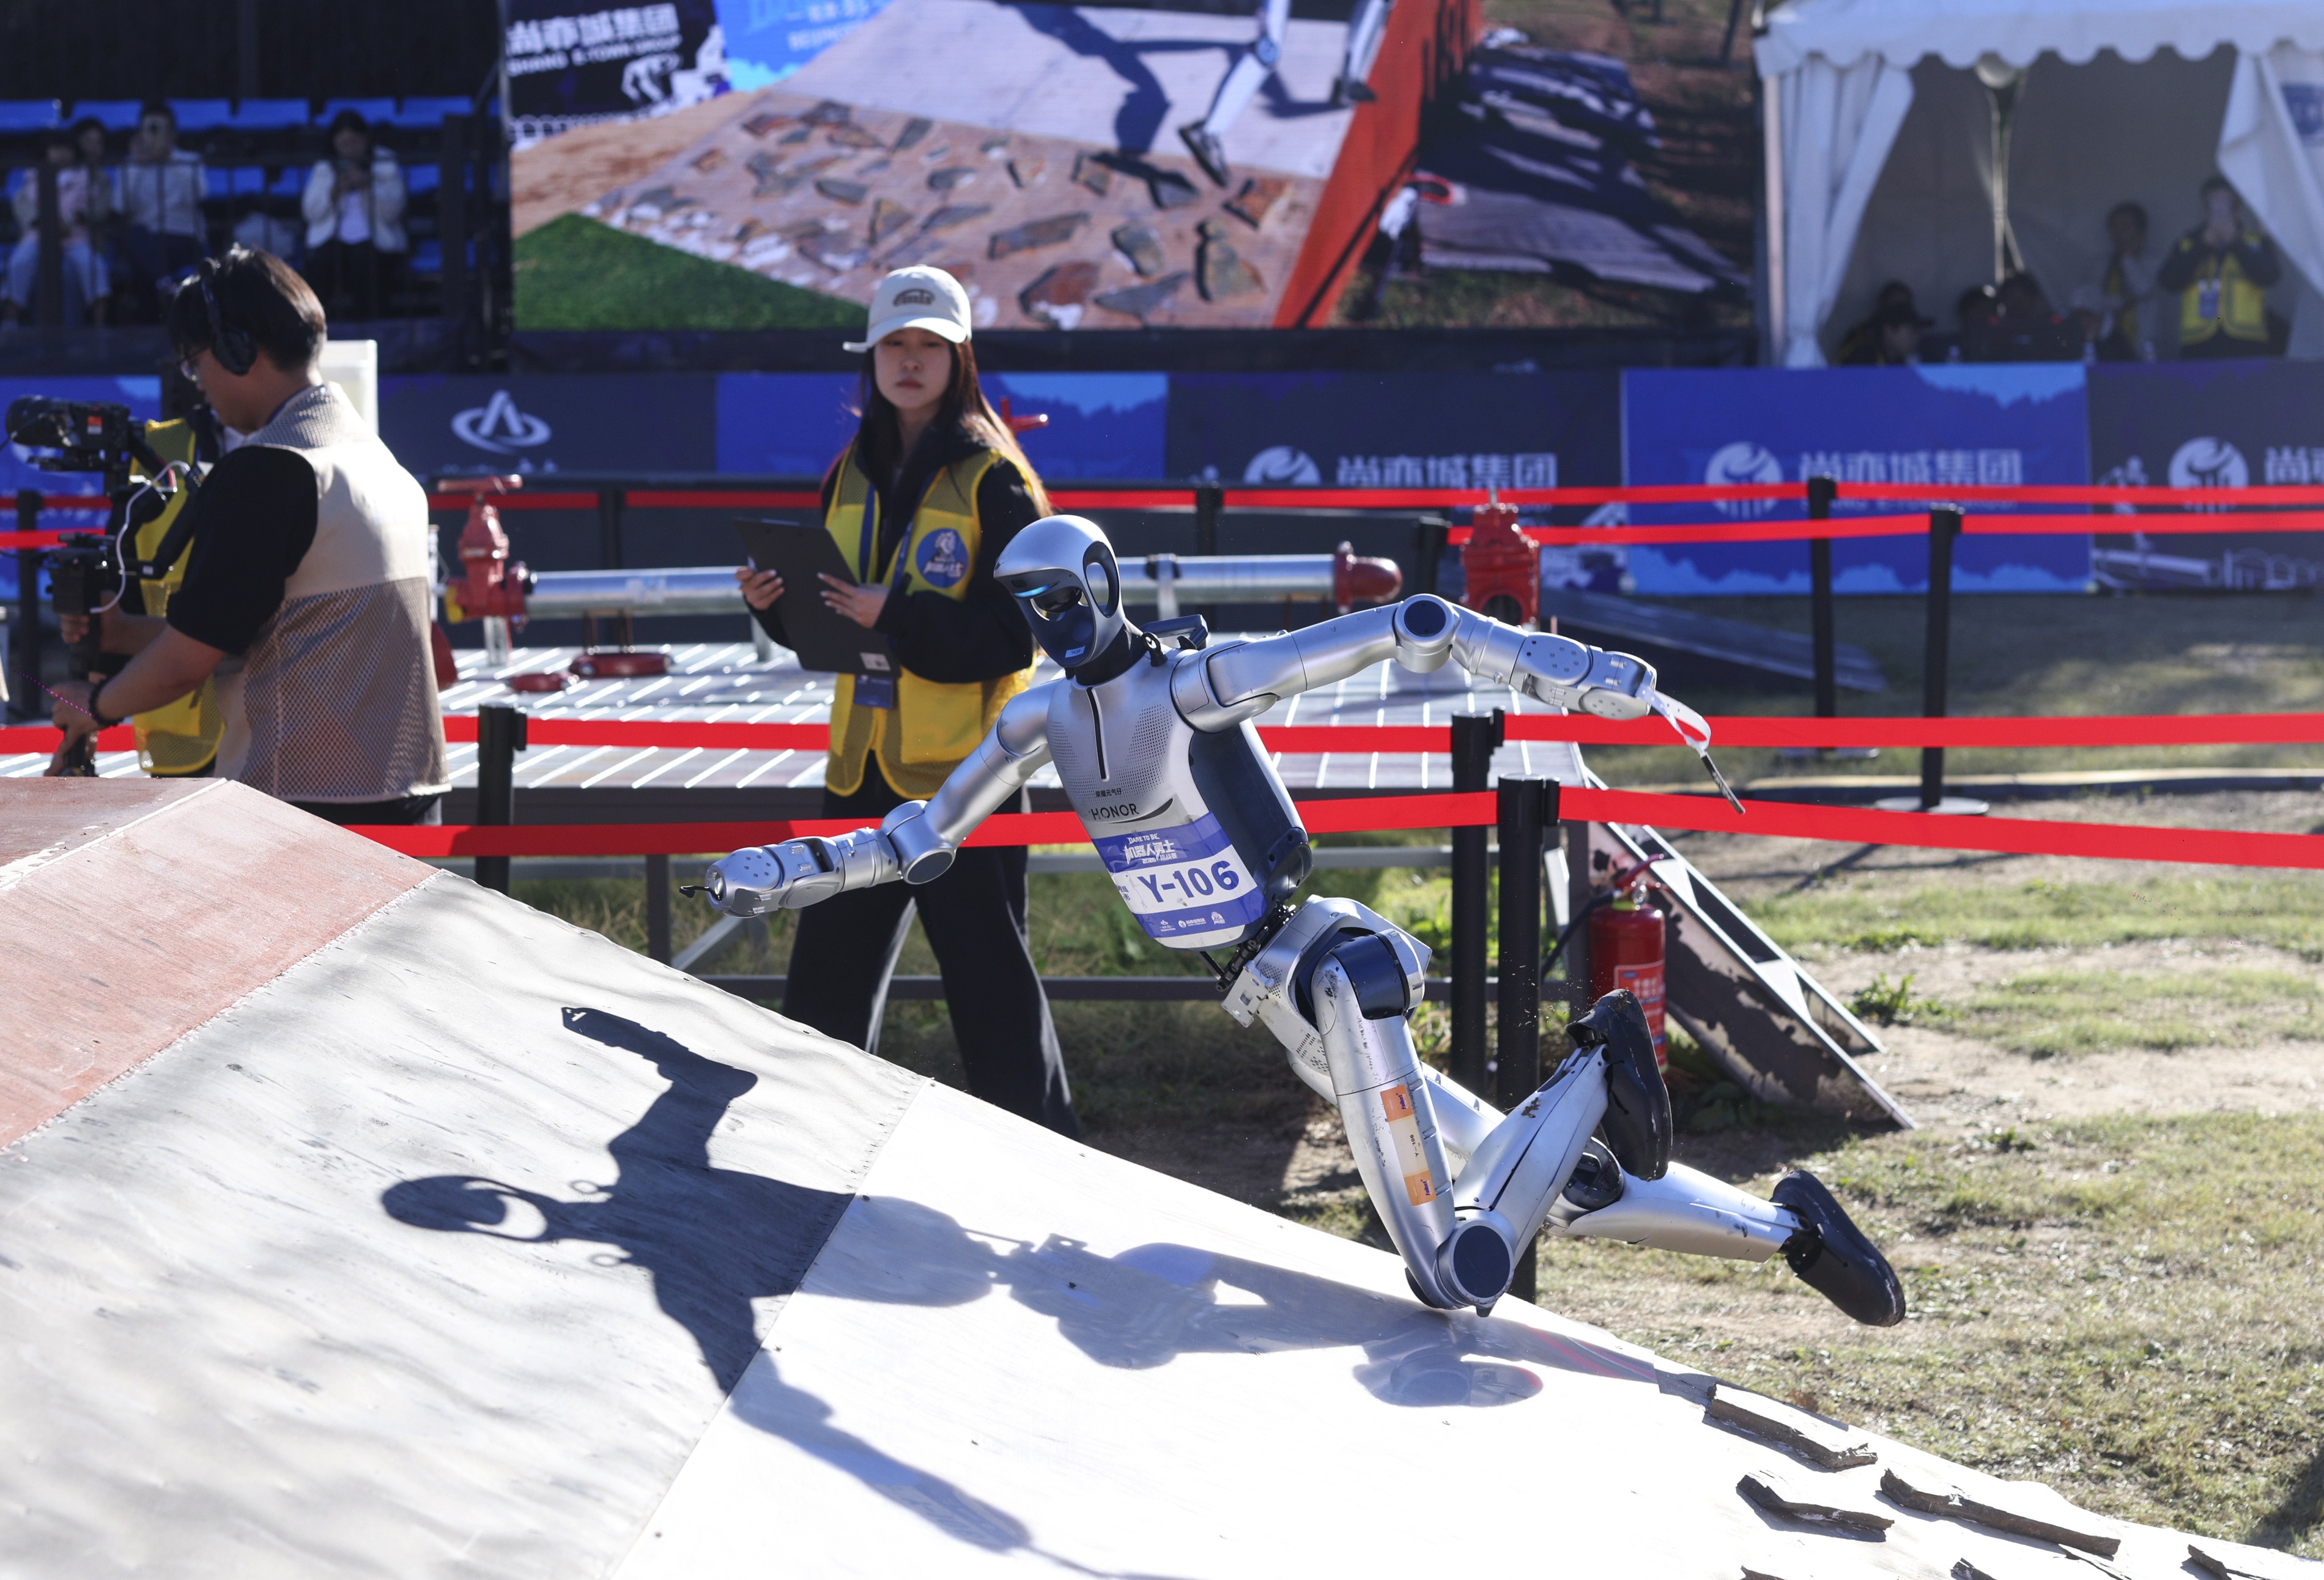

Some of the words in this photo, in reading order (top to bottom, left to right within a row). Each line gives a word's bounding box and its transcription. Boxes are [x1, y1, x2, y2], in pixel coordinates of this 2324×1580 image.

[505, 2, 680, 57] 尚亦城集团
[1095, 788, 1122, 798] 荣耀元气仔
[1090, 803, 1139, 820] HONOR
[1123, 840, 1175, 865] 机器人勇士
[1137, 860, 1240, 903] Y-106
